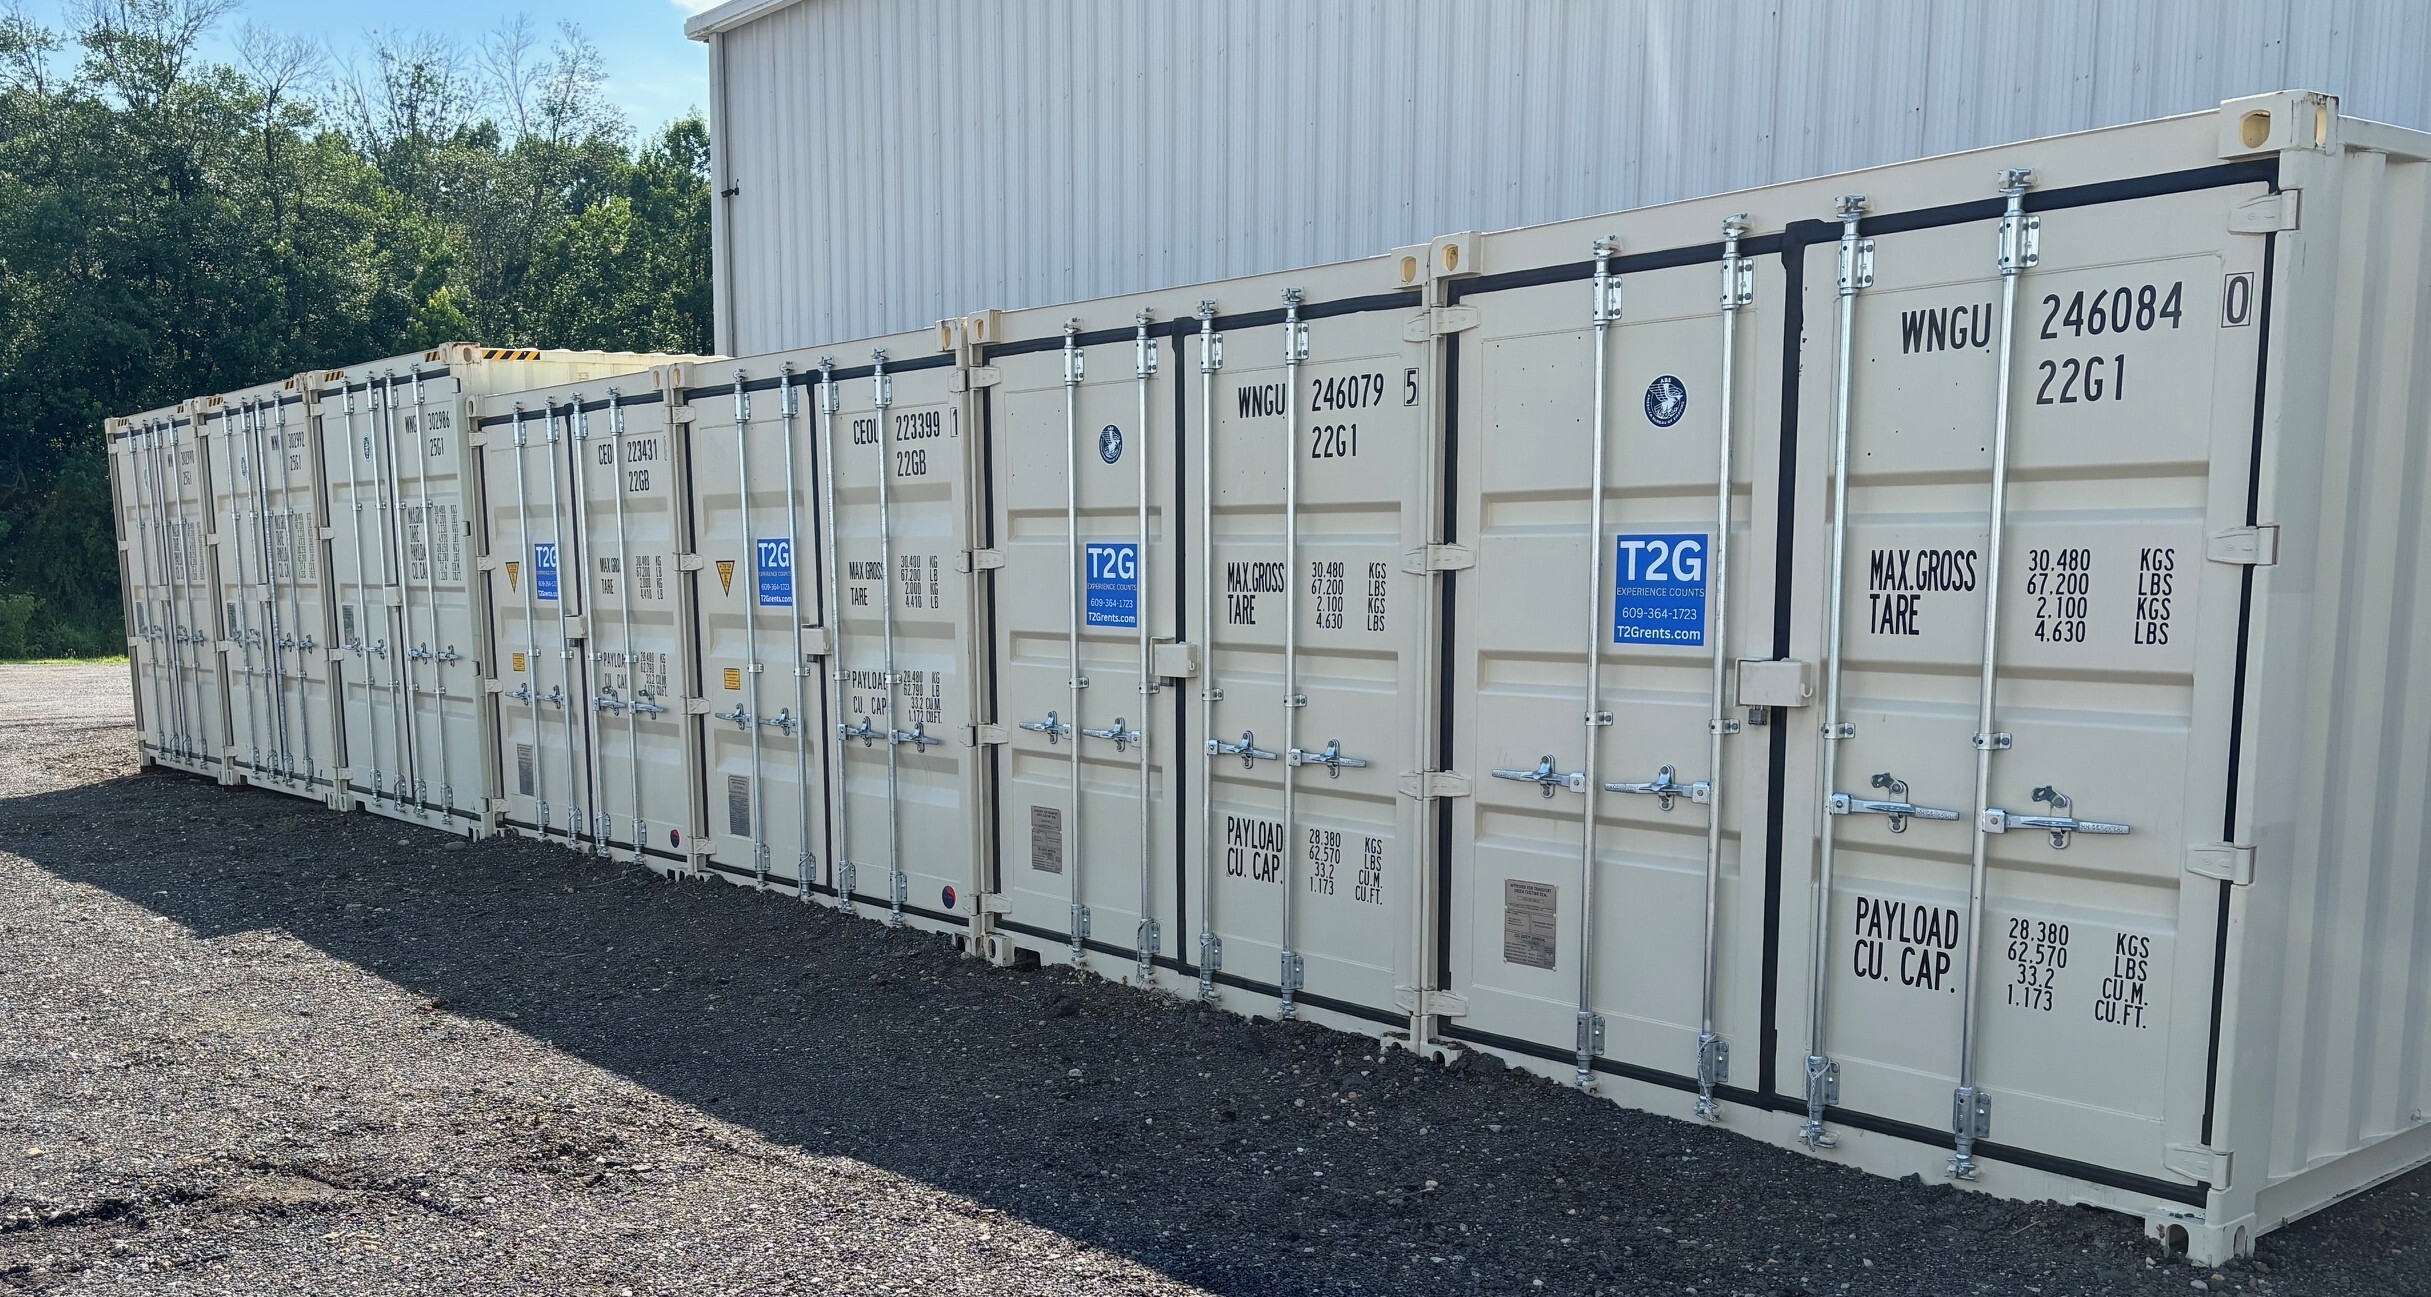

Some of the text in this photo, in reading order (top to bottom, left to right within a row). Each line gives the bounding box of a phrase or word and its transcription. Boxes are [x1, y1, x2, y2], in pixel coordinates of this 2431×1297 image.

[1902, 276, 2250, 354] WNGU 246084 0
[2036, 354, 2125, 405] 22G1
[1238, 370, 1417, 418] WNGU 246079 5
[405, 410, 450, 434] WNG 302986
[896, 411, 940, 441] 223399
[953, 409, 958, 435] 1
[430, 437, 444, 457] 25G1
[598, 439, 658, 465] CEO 223431
[1312, 424, 1356, 458] 22G1
[897, 449, 926, 477] 22GB
[629, 470, 650, 492] 22GB
[411, 544, 426, 561] PAYLOA
[611, 557, 620, 573] GRO
[759, 542, 789, 568] T2G
[1088, 548, 1134, 579] T2G
[1620, 540, 1701, 581] T2G
[849, 562, 864, 580] MAX
[929, 555, 938, 568] KG
[900, 569, 938, 581] 67.200 LB
[1228, 562, 1386, 592] MAX.GROSS 30.480 KGS
[1870, 548, 2174, 591] MAX.GROSS 30.480 KGS
[601, 579, 614, 594] TARE
[850, 588, 868, 606] TARE
[930, 583, 938, 595] KG
[1311, 579, 1386, 597] 67.200 LBS
[1616, 587, 1704, 597] EXPERIENCE COUNTS
[2027, 573, 2173, 596] 67.200 LBS
[905, 595, 939, 609] 4.410 LB
[1091, 598, 1133, 608] 609-364-1723
[1228, 594, 1385, 625] TARE 2.100 KGS
[1622, 607, 1697, 620] 609-364-1723
[1870, 594, 2171, 635] TARE 2.100 KGS
[1088, 612, 1135, 623] T2Grents.com
[1316, 613, 1384, 631] 4.630 LBS
[1617, 626, 1700, 640] T2Grents.com
[2034, 621, 2169, 645] 4.630 LBS
[603, 652, 626, 668] PAYLOA
[903, 684, 940, 697] 62.790 LB
[853, 696, 865, 714] CU.
[911, 697, 923, 709] 33.2
[909, 710, 924, 722] 1.172
[1227, 816, 1382, 855] PAYLOAD 28.380 KGS
[1227, 847, 1382, 888] CU. CAP. 33.2 CU.M.
[1309, 846, 1382, 871] 62.570 LBS
[1310, 877, 1382, 905] 1.173 CU.FT.
[1855, 896, 2150, 958] PAYLOAD 28.380 KGS
[1854, 939, 2148, 1006] CU. CAP. 33.2 CU.M.
[2007, 940, 2148, 982] 62.570 LBS
[2007, 984, 2147, 1029] 1.173 CU.FT.
